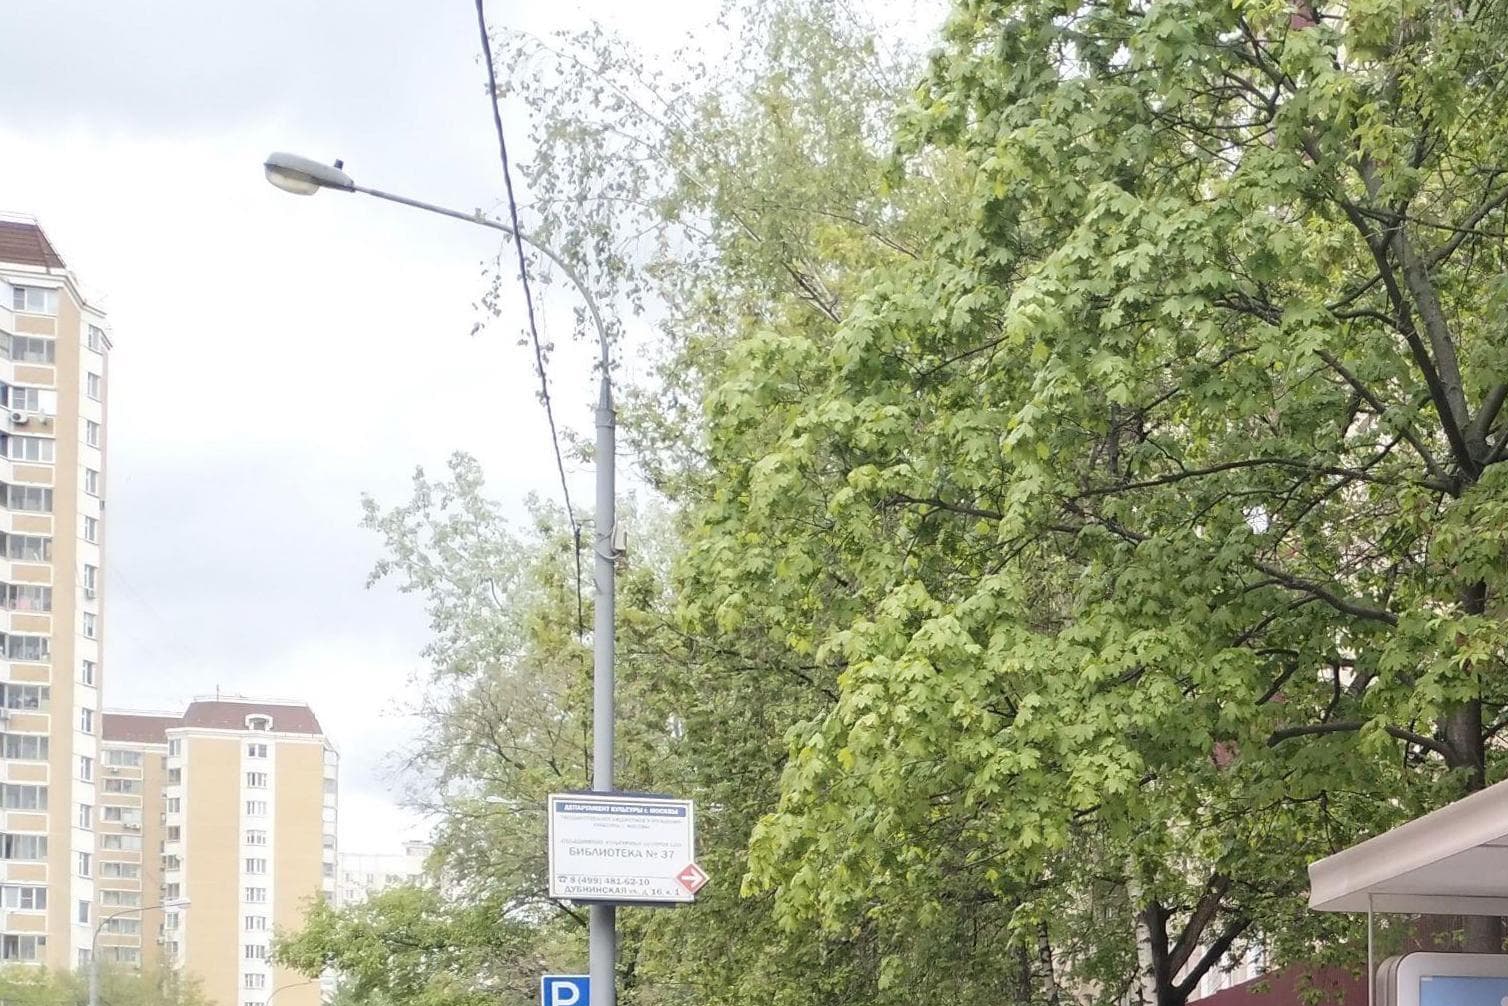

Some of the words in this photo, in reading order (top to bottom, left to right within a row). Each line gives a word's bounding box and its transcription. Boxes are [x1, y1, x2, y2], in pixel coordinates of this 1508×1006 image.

[568, 846, 643, 857] БИБЛИОТЕКА
[660, 850, 674, 859] 37
[564, 885, 628, 895] ДУБНИНСКАЯ
